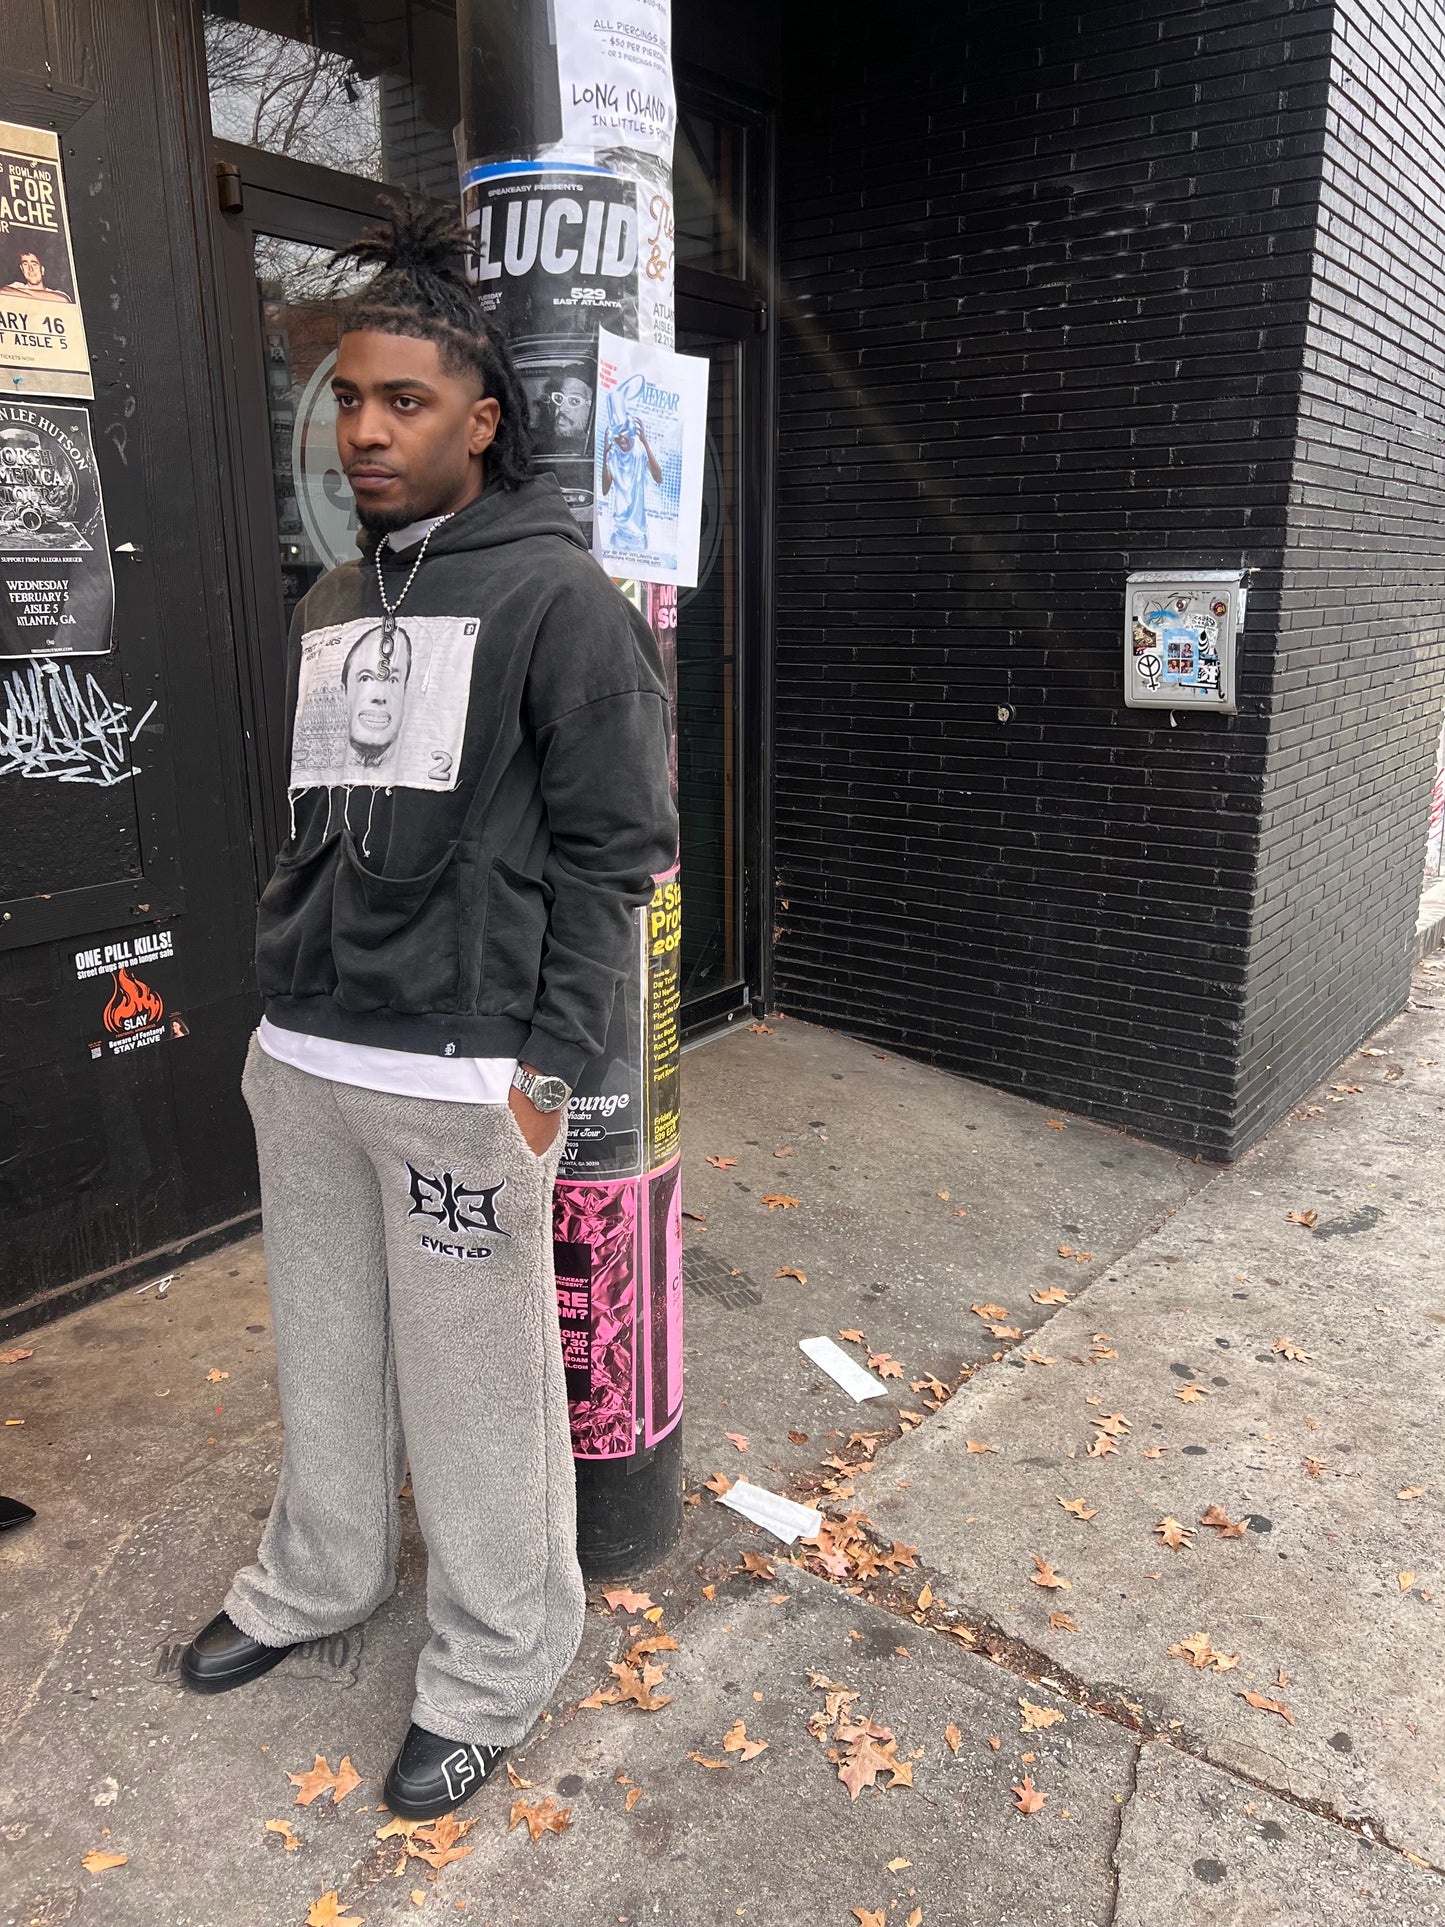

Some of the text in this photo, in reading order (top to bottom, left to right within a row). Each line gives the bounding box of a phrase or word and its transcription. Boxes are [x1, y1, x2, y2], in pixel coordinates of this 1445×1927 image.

[593, 19, 613, 30] ALL
[572, 83, 665, 122] LONG ISLAND
[592, 115, 607, 128] IN
[611, 117, 646, 133] LITTLE
[9, 164, 51, 181] ROWLAND
[9, 175, 55, 204] FOR
[466, 198, 638, 281] ELUCID
[570, 287, 606, 300] 529
[581, 299, 622, 308] ATLANTA
[42, 316, 65, 334] 16
[15, 334, 53, 348] AISLE
[59, 338, 68, 349] 5
[9, 407, 37, 425] LEE
[38, 416, 89, 471] HUTSON
[0, 446, 55, 467] ORTH
[6, 580, 69, 590] WEDNESDAY
[9, 591, 69, 602] FEBRUARY 5
[24, 604, 59, 614] AISLE 5
[16, 615, 77, 626] ATLANTA, GA
[428, 751, 454, 781] 2
[75, 931, 172, 970] ONE PILL KILLS!
[77, 949, 174, 980] Street drugs are no longer safe
[124, 1014, 148, 1031] SLAY
[109, 1036, 131, 1049] Beware
[132, 1032, 139, 1042] of
[139, 1026, 165, 1040] Fentanyl
[113, 1042, 135, 1055] STAY
[137, 1035, 161, 1048] ALIVE
[567, 1094, 631, 1117] ounge
[560, 1149, 578, 1160] AV
[420, 1236, 493, 1260] EVICTED
[555, 1275, 589, 1284] PEAKEASY
[556, 1290, 588, 1308] RE
[560, 1329, 589, 1339] IGHT
[570, 1338, 589, 1347] 30
[566, 1346, 588, 1355] ATL
